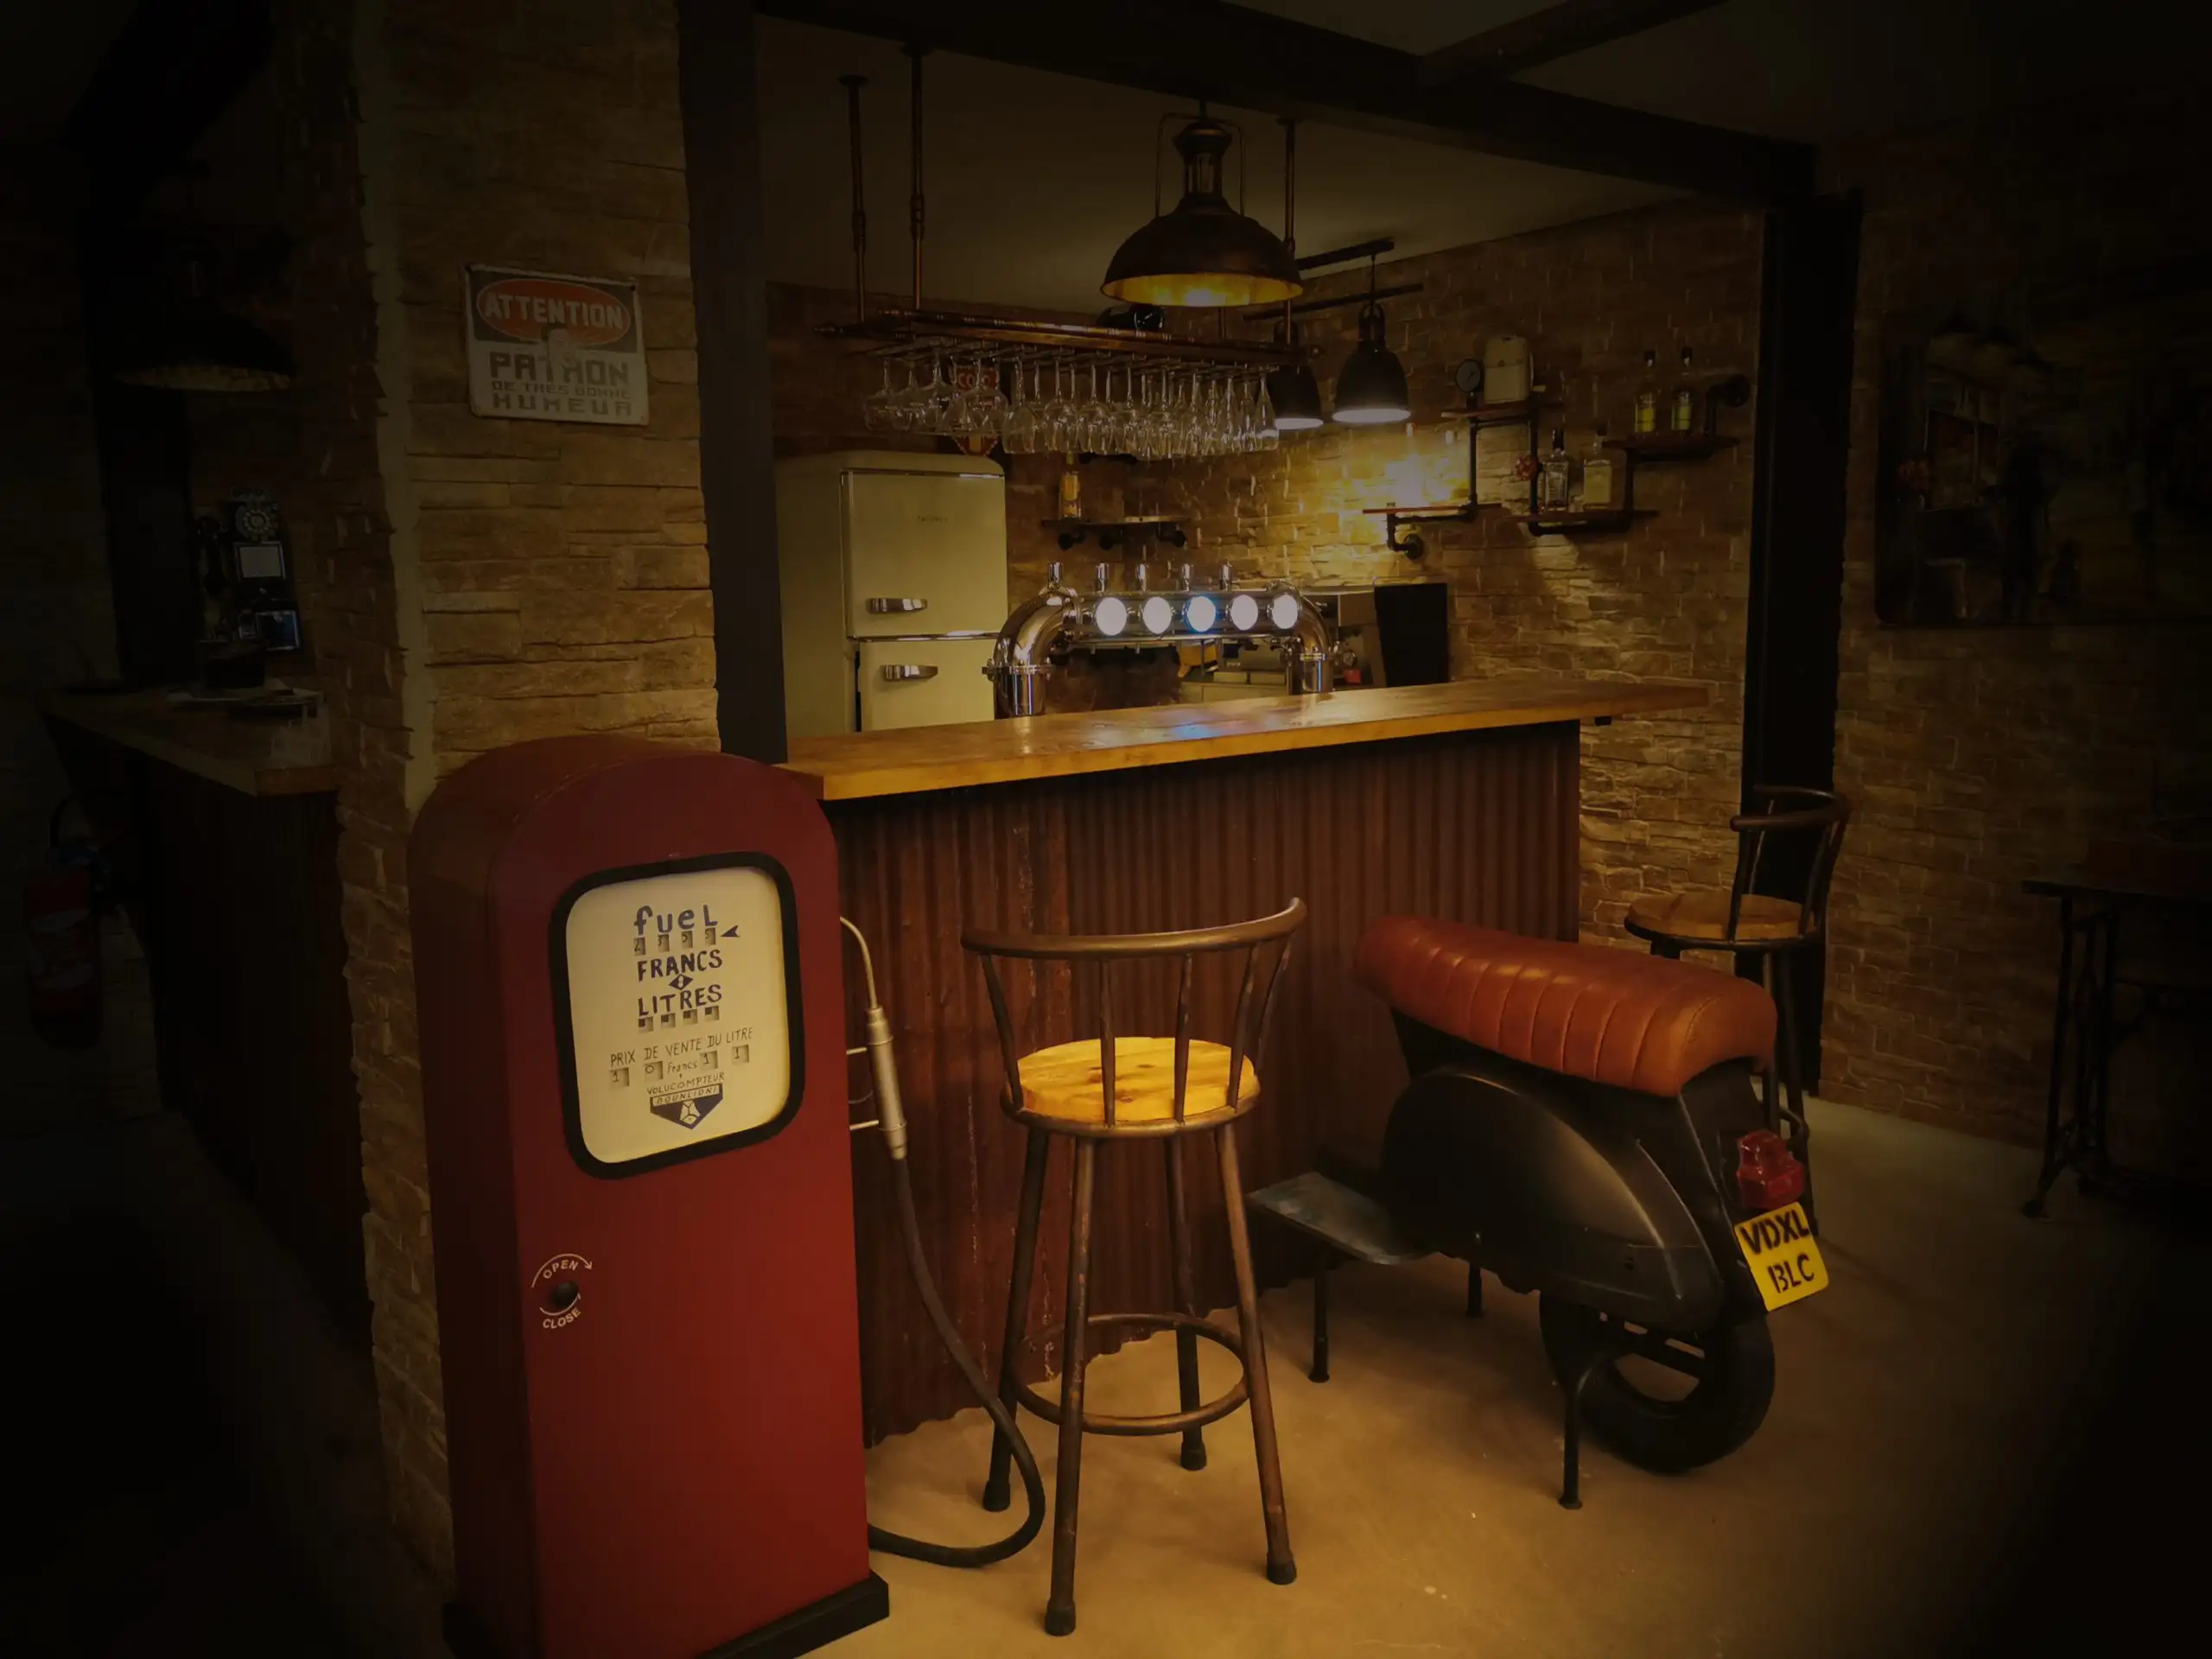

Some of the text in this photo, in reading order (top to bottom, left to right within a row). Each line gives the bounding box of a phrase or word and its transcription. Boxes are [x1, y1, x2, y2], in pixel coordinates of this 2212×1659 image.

[485, 292, 624, 330] ATTENTION
[493, 394, 632, 416] HUMEUR
[638, 949, 722, 982] FRANCS
[638, 984, 722, 1016] LITRES
[610, 1027, 753, 1067] PRIX DE VENTE DU LITRE
[647, 1071, 725, 1096] VOLUCOMPTEUR
[1740, 1210, 1809, 1255] VDXL
[543, 1260, 579, 1279] OPEN
[543, 1307, 582, 1329] CLOSE
